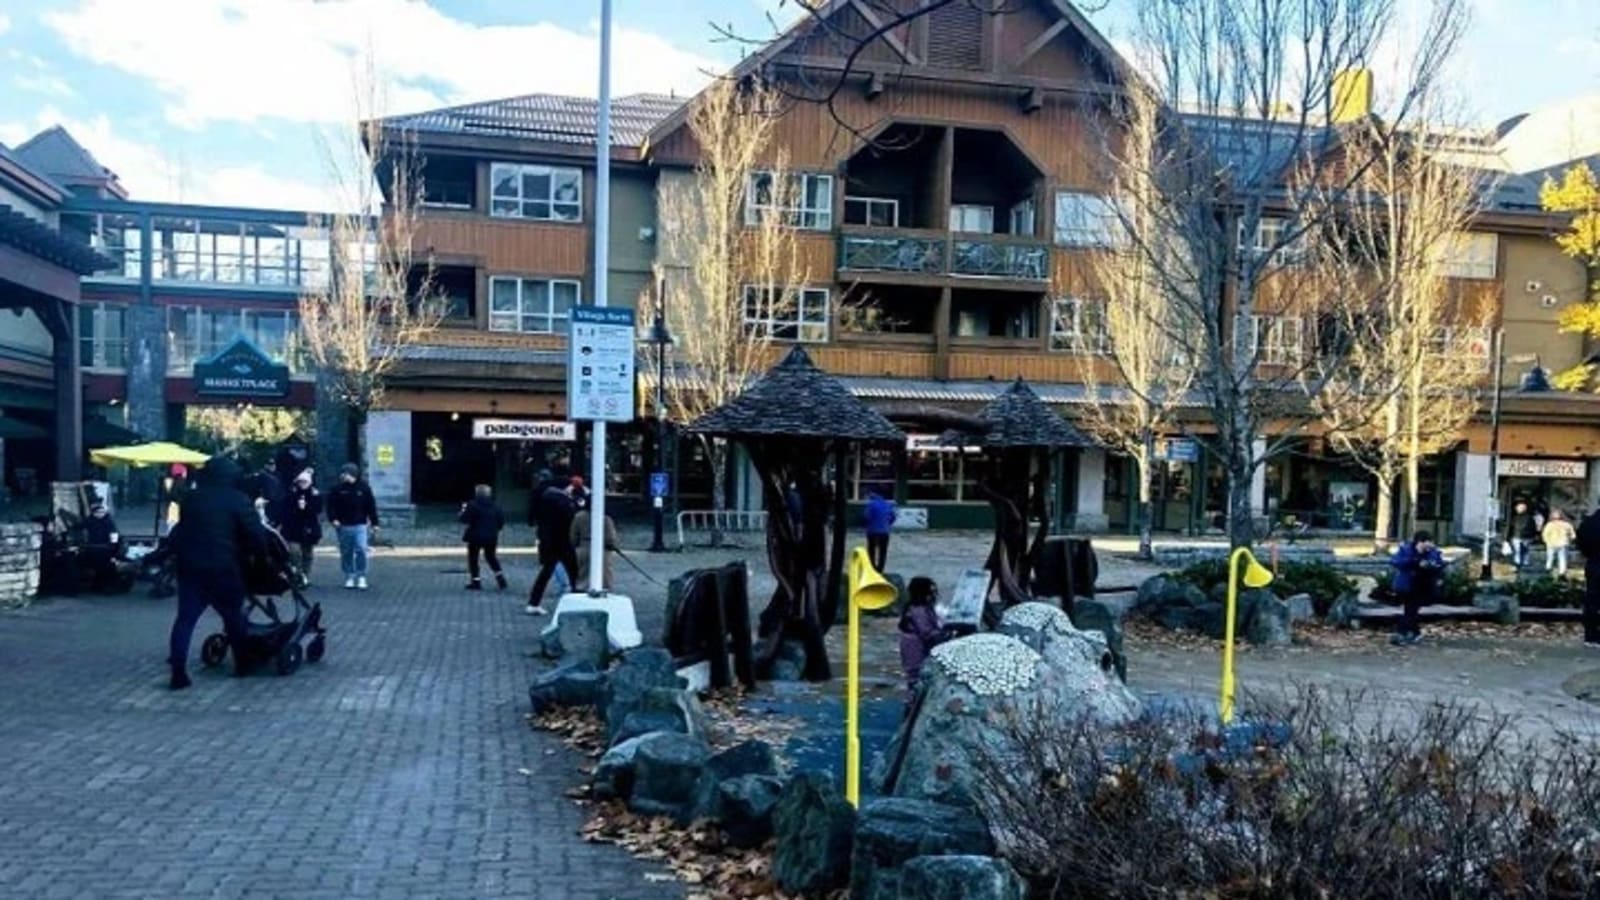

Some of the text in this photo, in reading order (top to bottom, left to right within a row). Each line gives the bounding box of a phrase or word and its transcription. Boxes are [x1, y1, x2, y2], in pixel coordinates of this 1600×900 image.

[577, 310, 605, 321] Village
[204, 378, 277, 389] MARKETPLACE
[484, 424, 564, 436] patagonia
